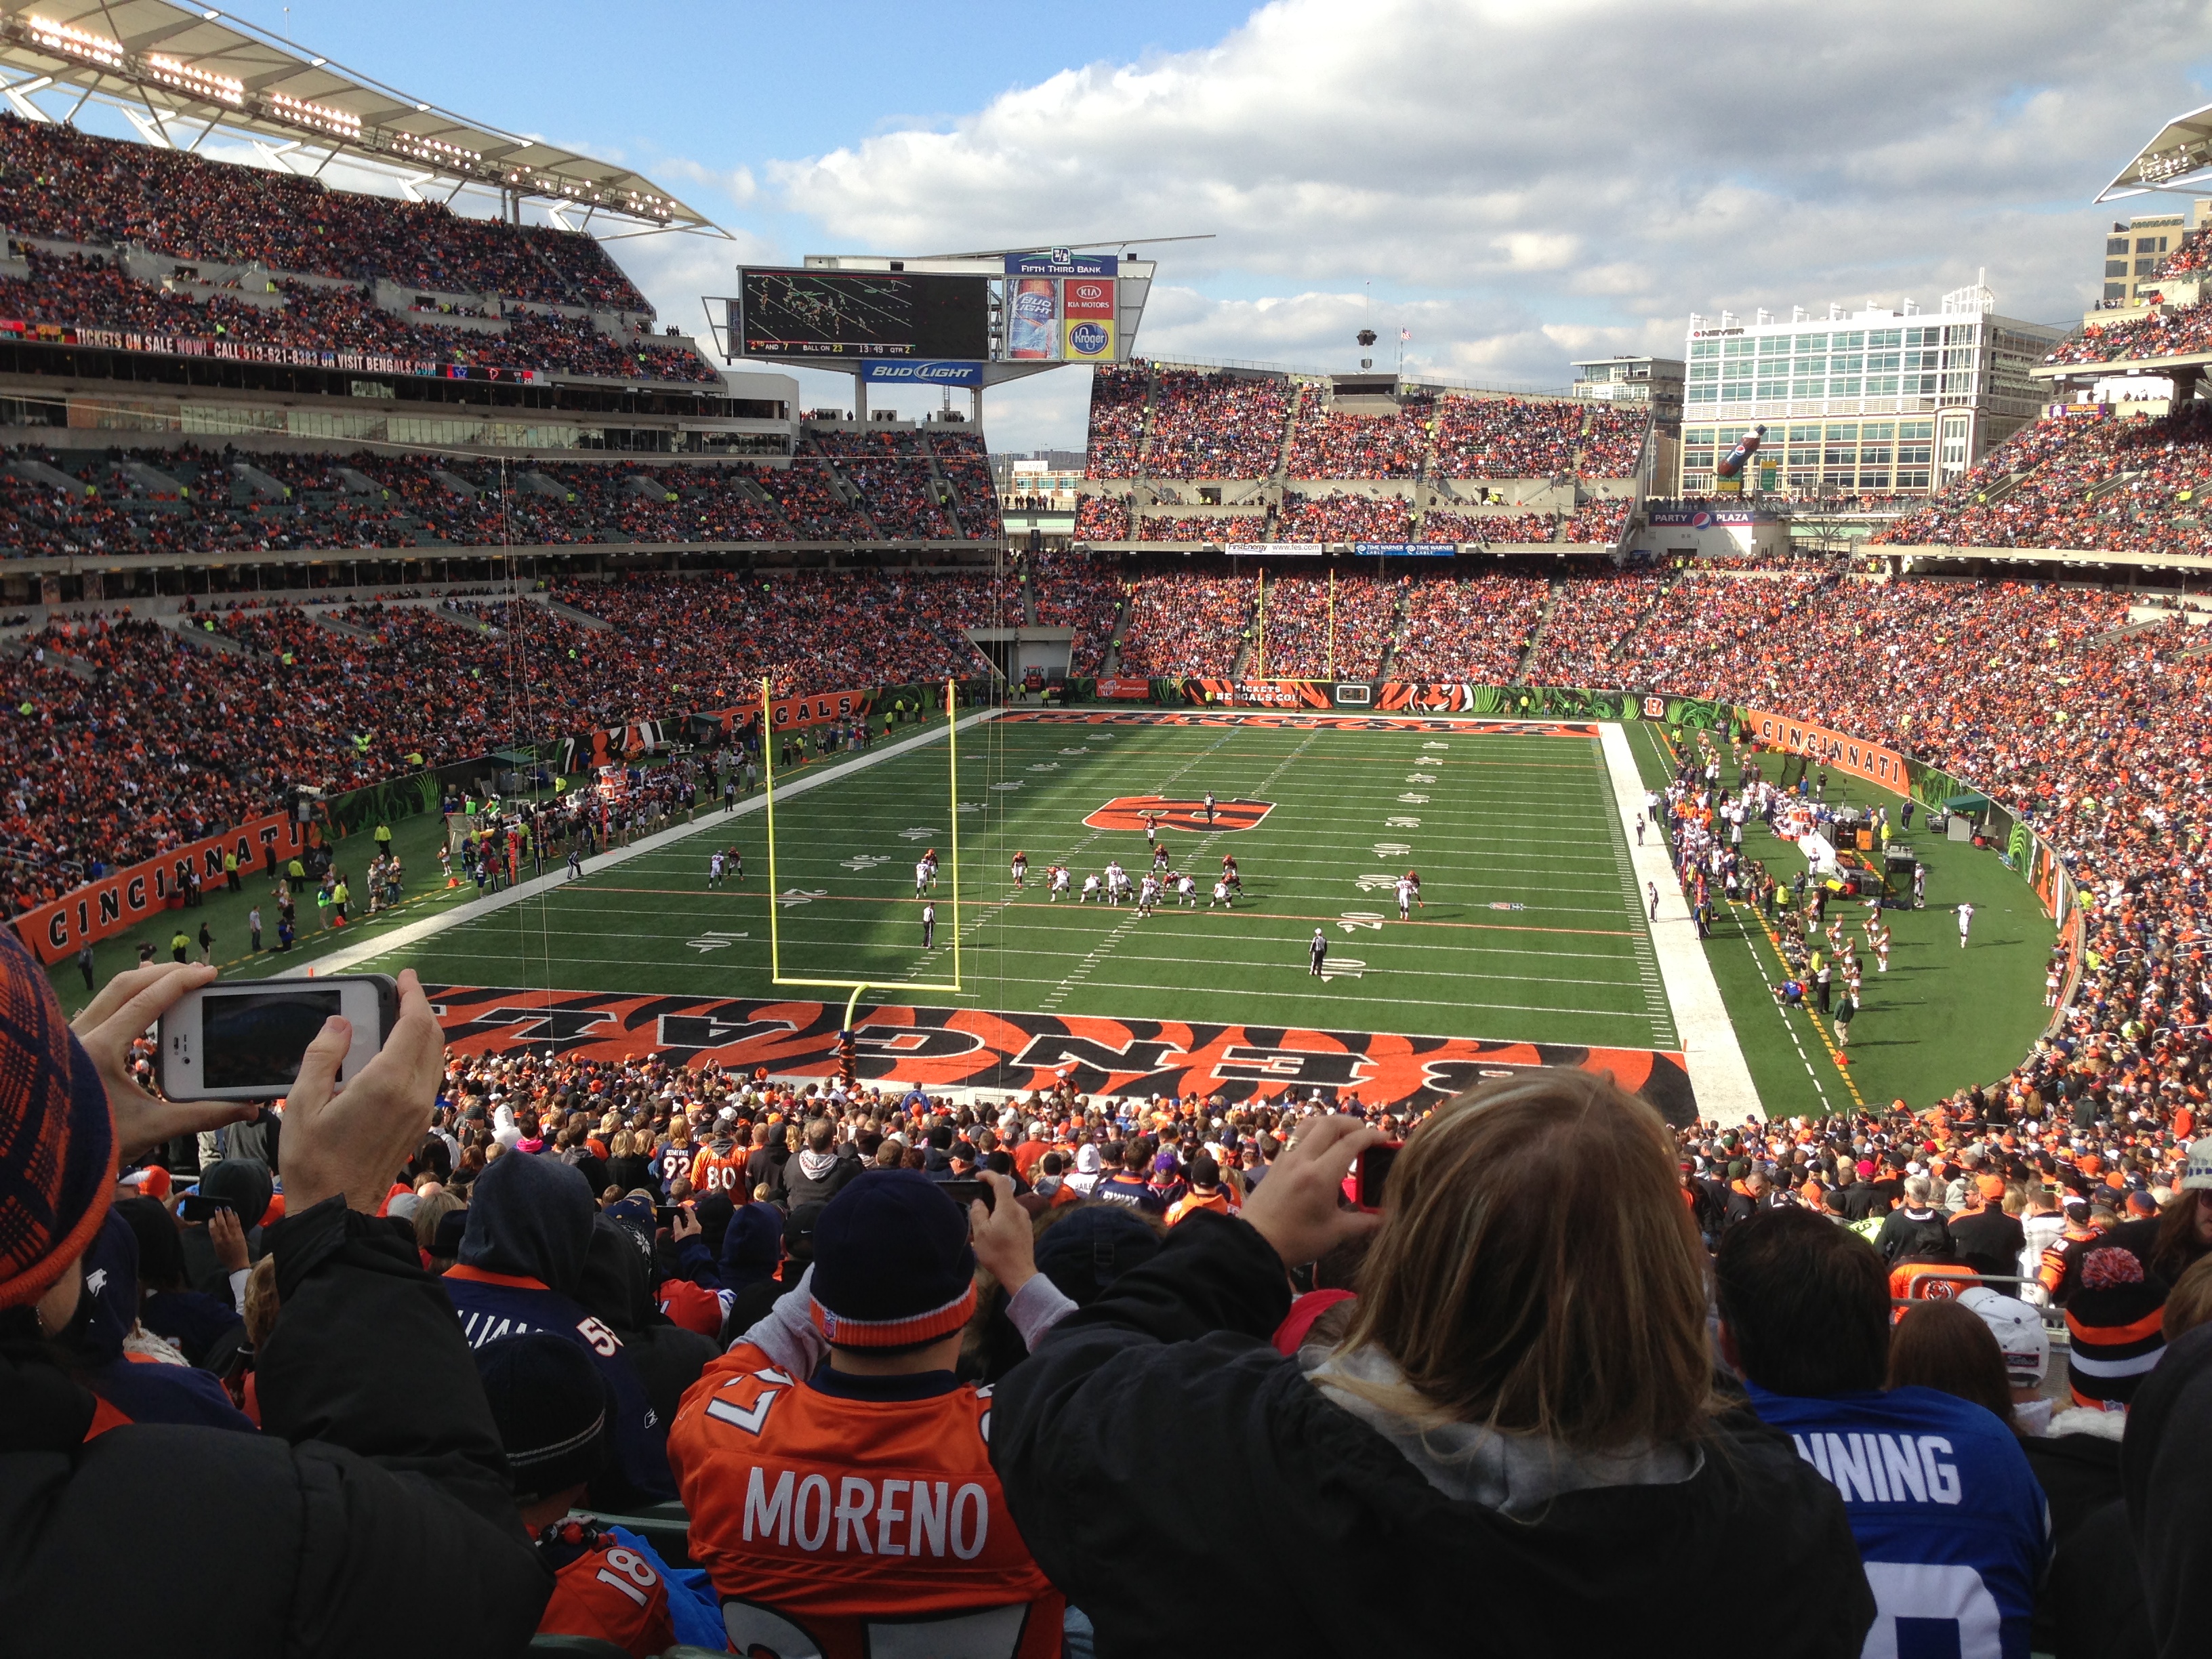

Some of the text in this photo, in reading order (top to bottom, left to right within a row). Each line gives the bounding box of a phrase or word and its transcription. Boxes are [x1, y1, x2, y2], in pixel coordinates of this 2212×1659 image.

[1048, 265, 1075, 273] THIRD
[1080, 288, 1098, 296] KIA
[1020, 296, 1052, 307] BUD
[1016, 304, 1052, 314] LIGHT
[1701, 327, 1744, 337] NEYER
[1075, 327, 1105, 350] Kroger
[75, 327, 122, 349] TICKETS
[125, 334, 142, 351] ON
[145, 336, 173, 353] SALE
[176, 339, 207, 356] NOW!
[213, 342, 240, 359] CALL
[321, 350, 335, 368] OR
[337, 353, 363, 369] VISIT
[366, 356, 436, 377] BENGALS.COM
[783, 342, 789, 351] 7
[832, 344, 843, 352] 23
[859, 344, 884, 354] 13:49
[905, 346, 911, 354] 2
[872, 366, 973, 378] BUD LIGHT
[1717, 514, 1749, 522] PLAZA
[1228, 543, 1267, 553] FirstEnergy
[729, 697, 852, 731] ENGALS
[1762, 719, 1900, 785] CINCINNATI
[432, 1004, 1559, 1095] BENGAL
[663, 1156, 691, 1180] 92
[707, 1166, 736, 1190] 80
[1075, 1183, 1097, 1191] BAILE
[742, 1466, 989, 1560] MORENO
[595, 1548, 657, 1607] 18
